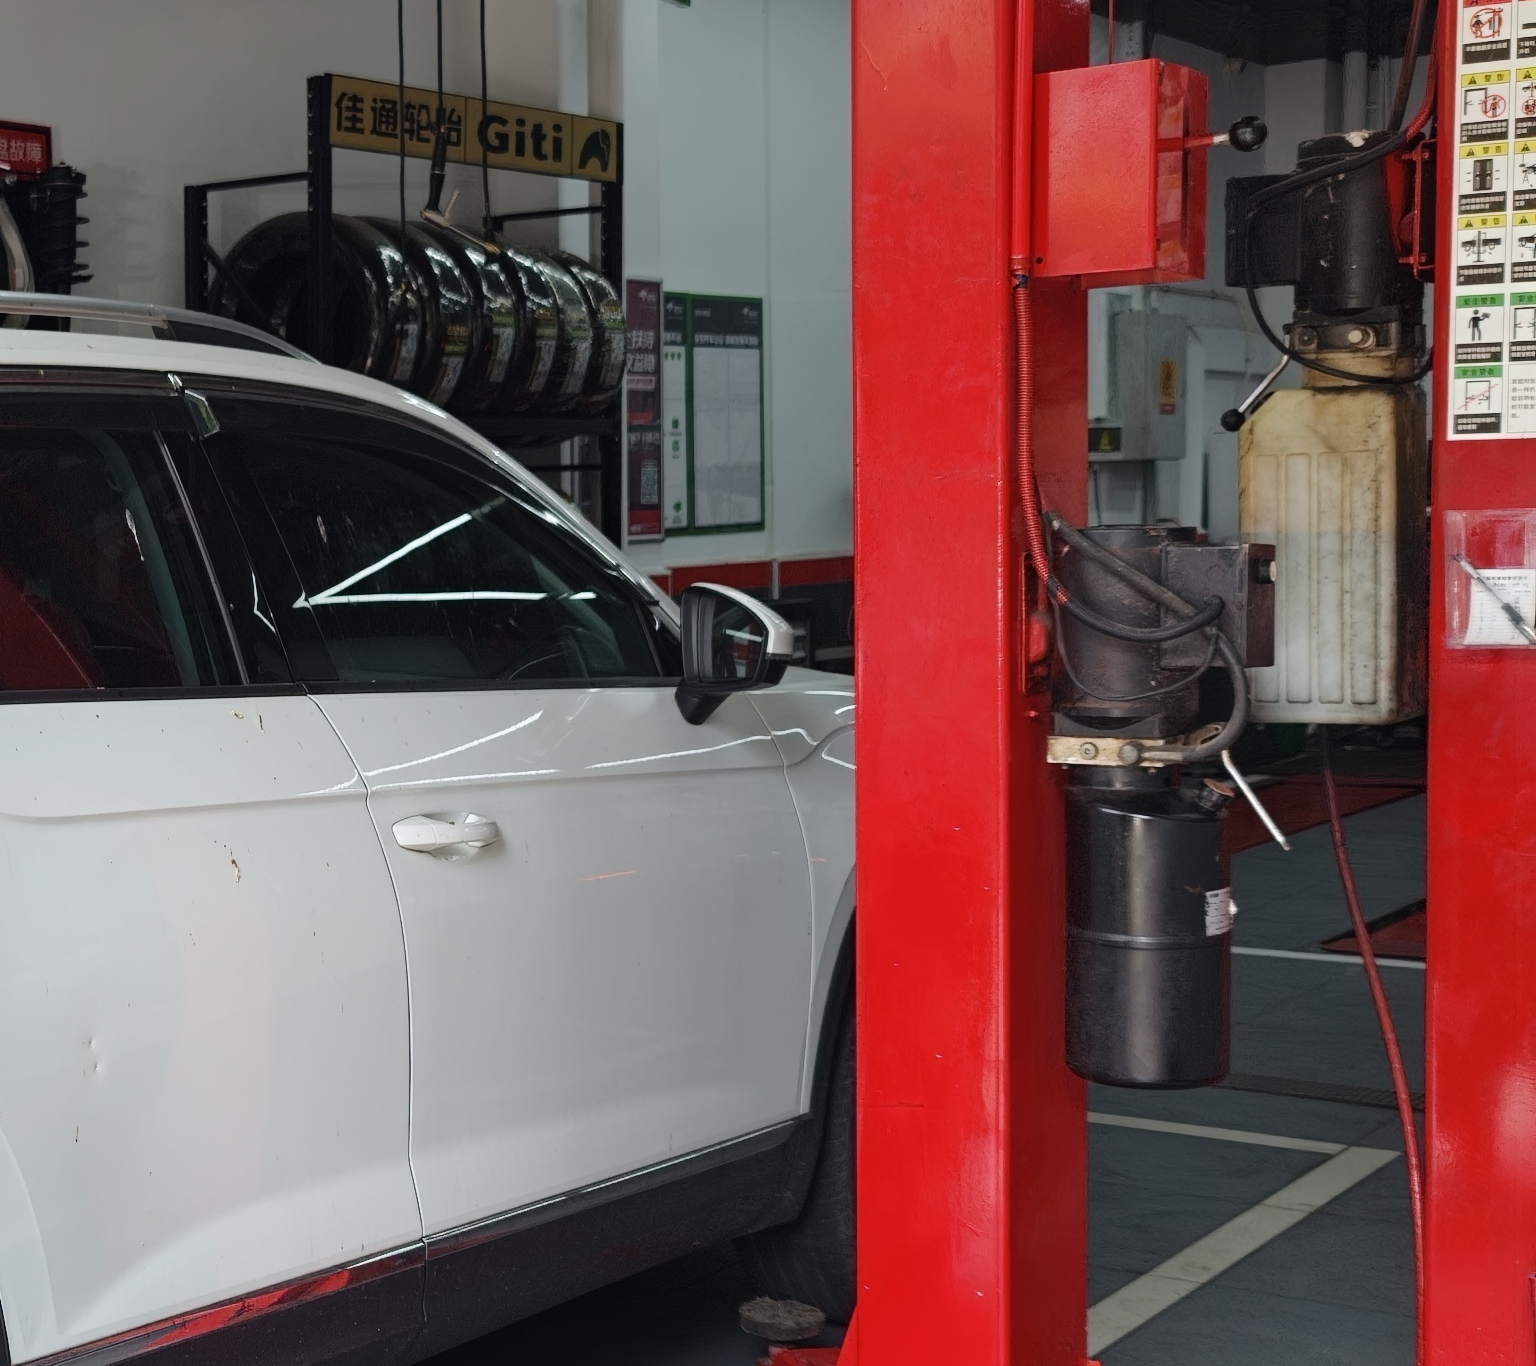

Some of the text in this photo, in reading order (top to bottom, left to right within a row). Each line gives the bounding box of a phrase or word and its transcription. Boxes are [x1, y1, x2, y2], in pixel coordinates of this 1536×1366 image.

[334, 91, 462, 148] 佳通轮胎
[477, 114, 563, 163] Giti
